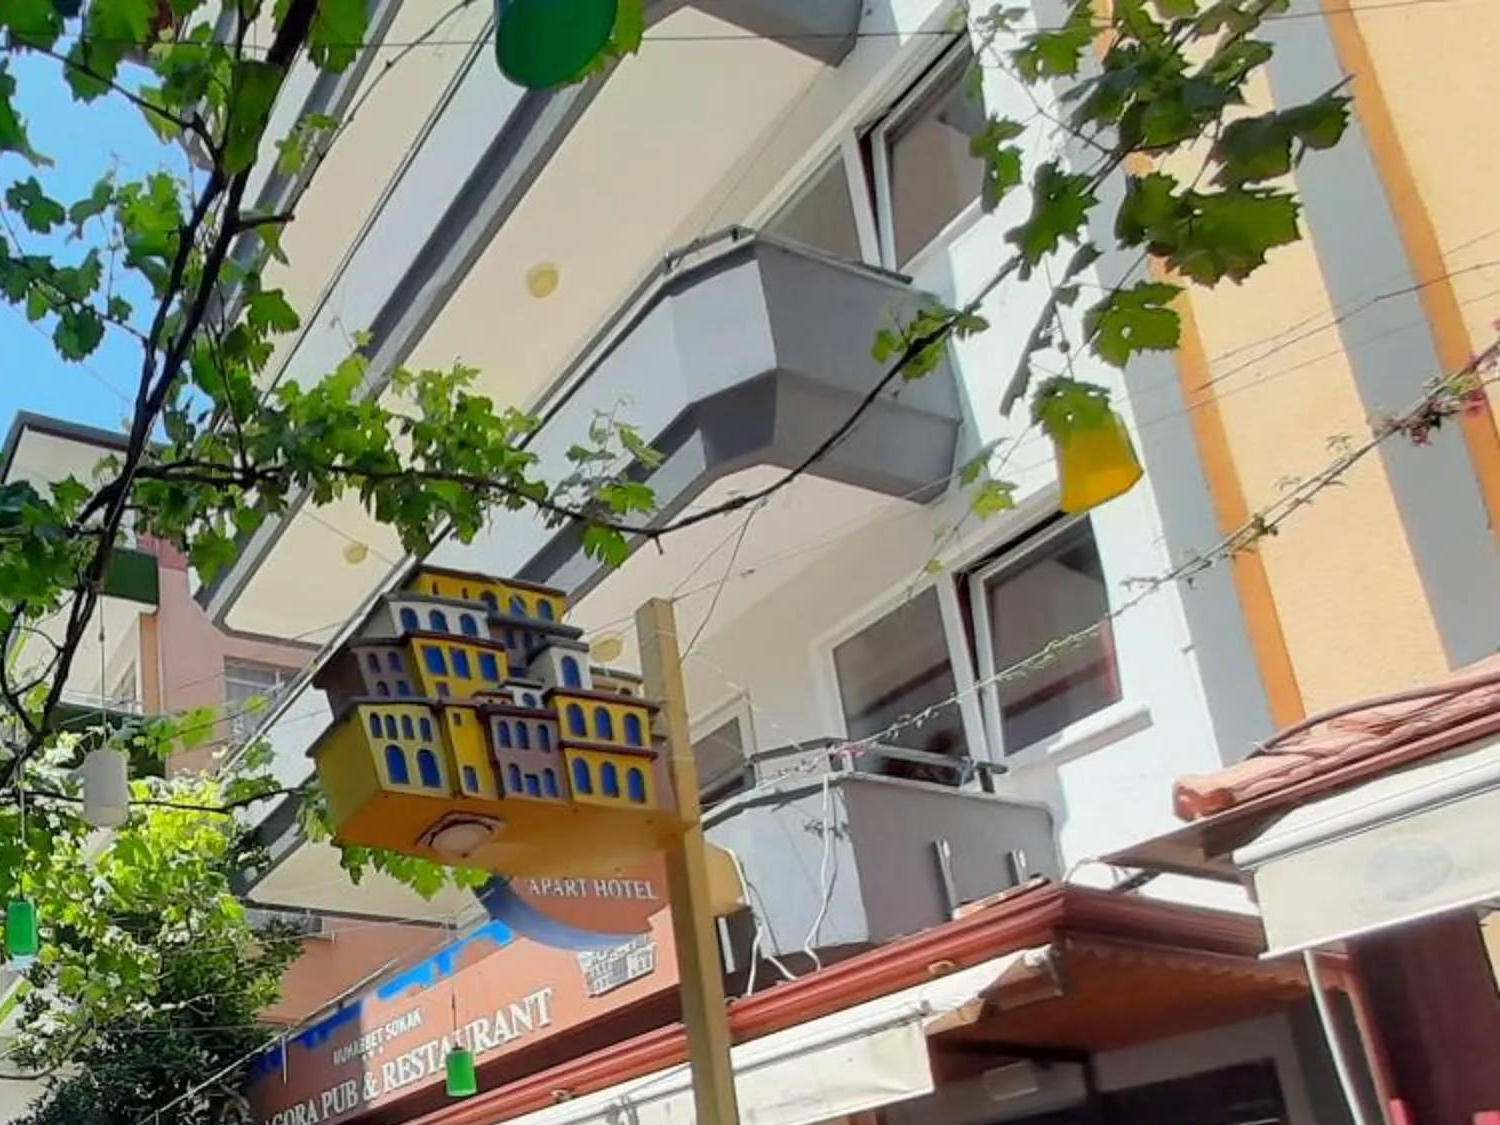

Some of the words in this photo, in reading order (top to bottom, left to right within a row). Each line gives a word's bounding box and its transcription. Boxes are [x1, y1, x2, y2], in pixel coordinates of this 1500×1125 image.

[528, 877, 588, 898] APART
[592, 878, 658, 900] HOTEL
[320, 1079, 359, 1120] PUB
[362, 1071, 381, 1102] &
